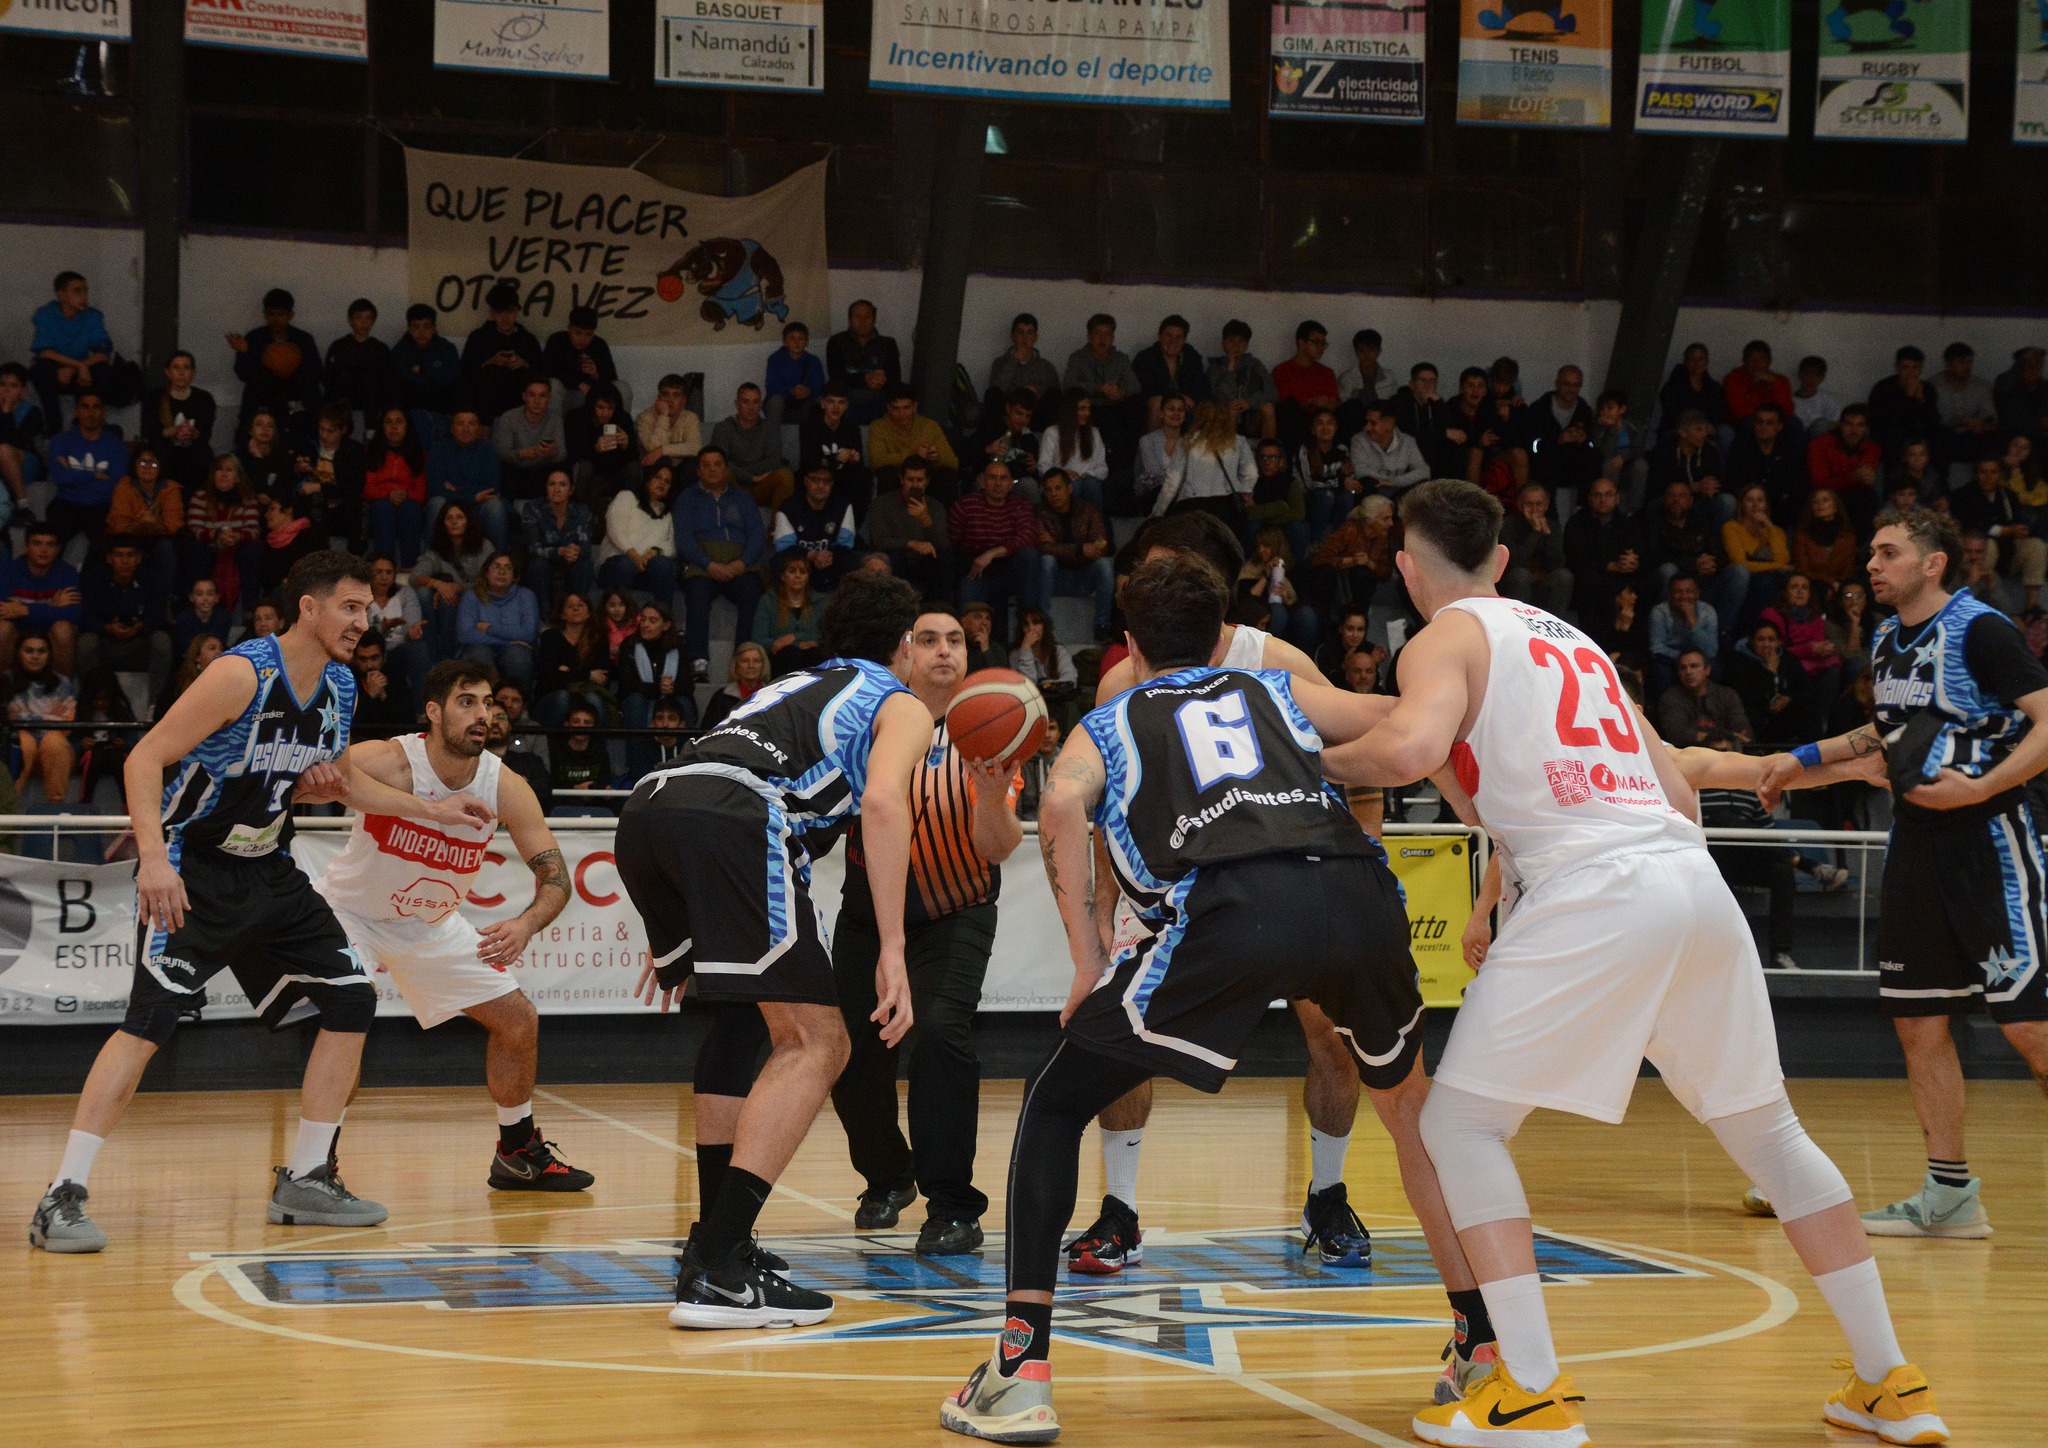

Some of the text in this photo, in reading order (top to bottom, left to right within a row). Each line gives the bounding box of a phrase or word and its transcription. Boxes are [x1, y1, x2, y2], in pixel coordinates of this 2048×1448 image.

[246, 1, 362, 23] Construcciones
[696, 2, 782, 20] BASQUET
[904, 5, 979, 24] SANTA
[990, 14, 1054, 32] ROSA
[1082, 19, 1106, 33] LA
[1119, 18, 1197, 37] PAMPA
[691, 25, 790, 54] Ñamandú
[1283, 37, 1410, 56] GIM. ARTISTICA
[741, 55, 795, 70] Calzados
[888, 43, 1213, 85] Incentivando el deporte
[1509, 48, 1559, 64] TENIS
[1679, 56, 1746, 71] FUTBOL
[1861, 61, 1921, 76] RUGBY
[1302, 60, 1418, 99] Z electricidad
[1648, 91, 1751, 110] PASSWORD
[426, 182, 690, 239] QUE PLACER
[488, 235, 630, 276] VERTE
[571, 281, 657, 320] VEZ
[1145, 673, 1230, 698] playmaker
[1528, 637, 1640, 755] 23
[1174, 689, 1265, 794] 6
[57, 879, 97, 933] B
[391, 893, 460, 909] NISSAN
[616, 921, 630, 941] &
